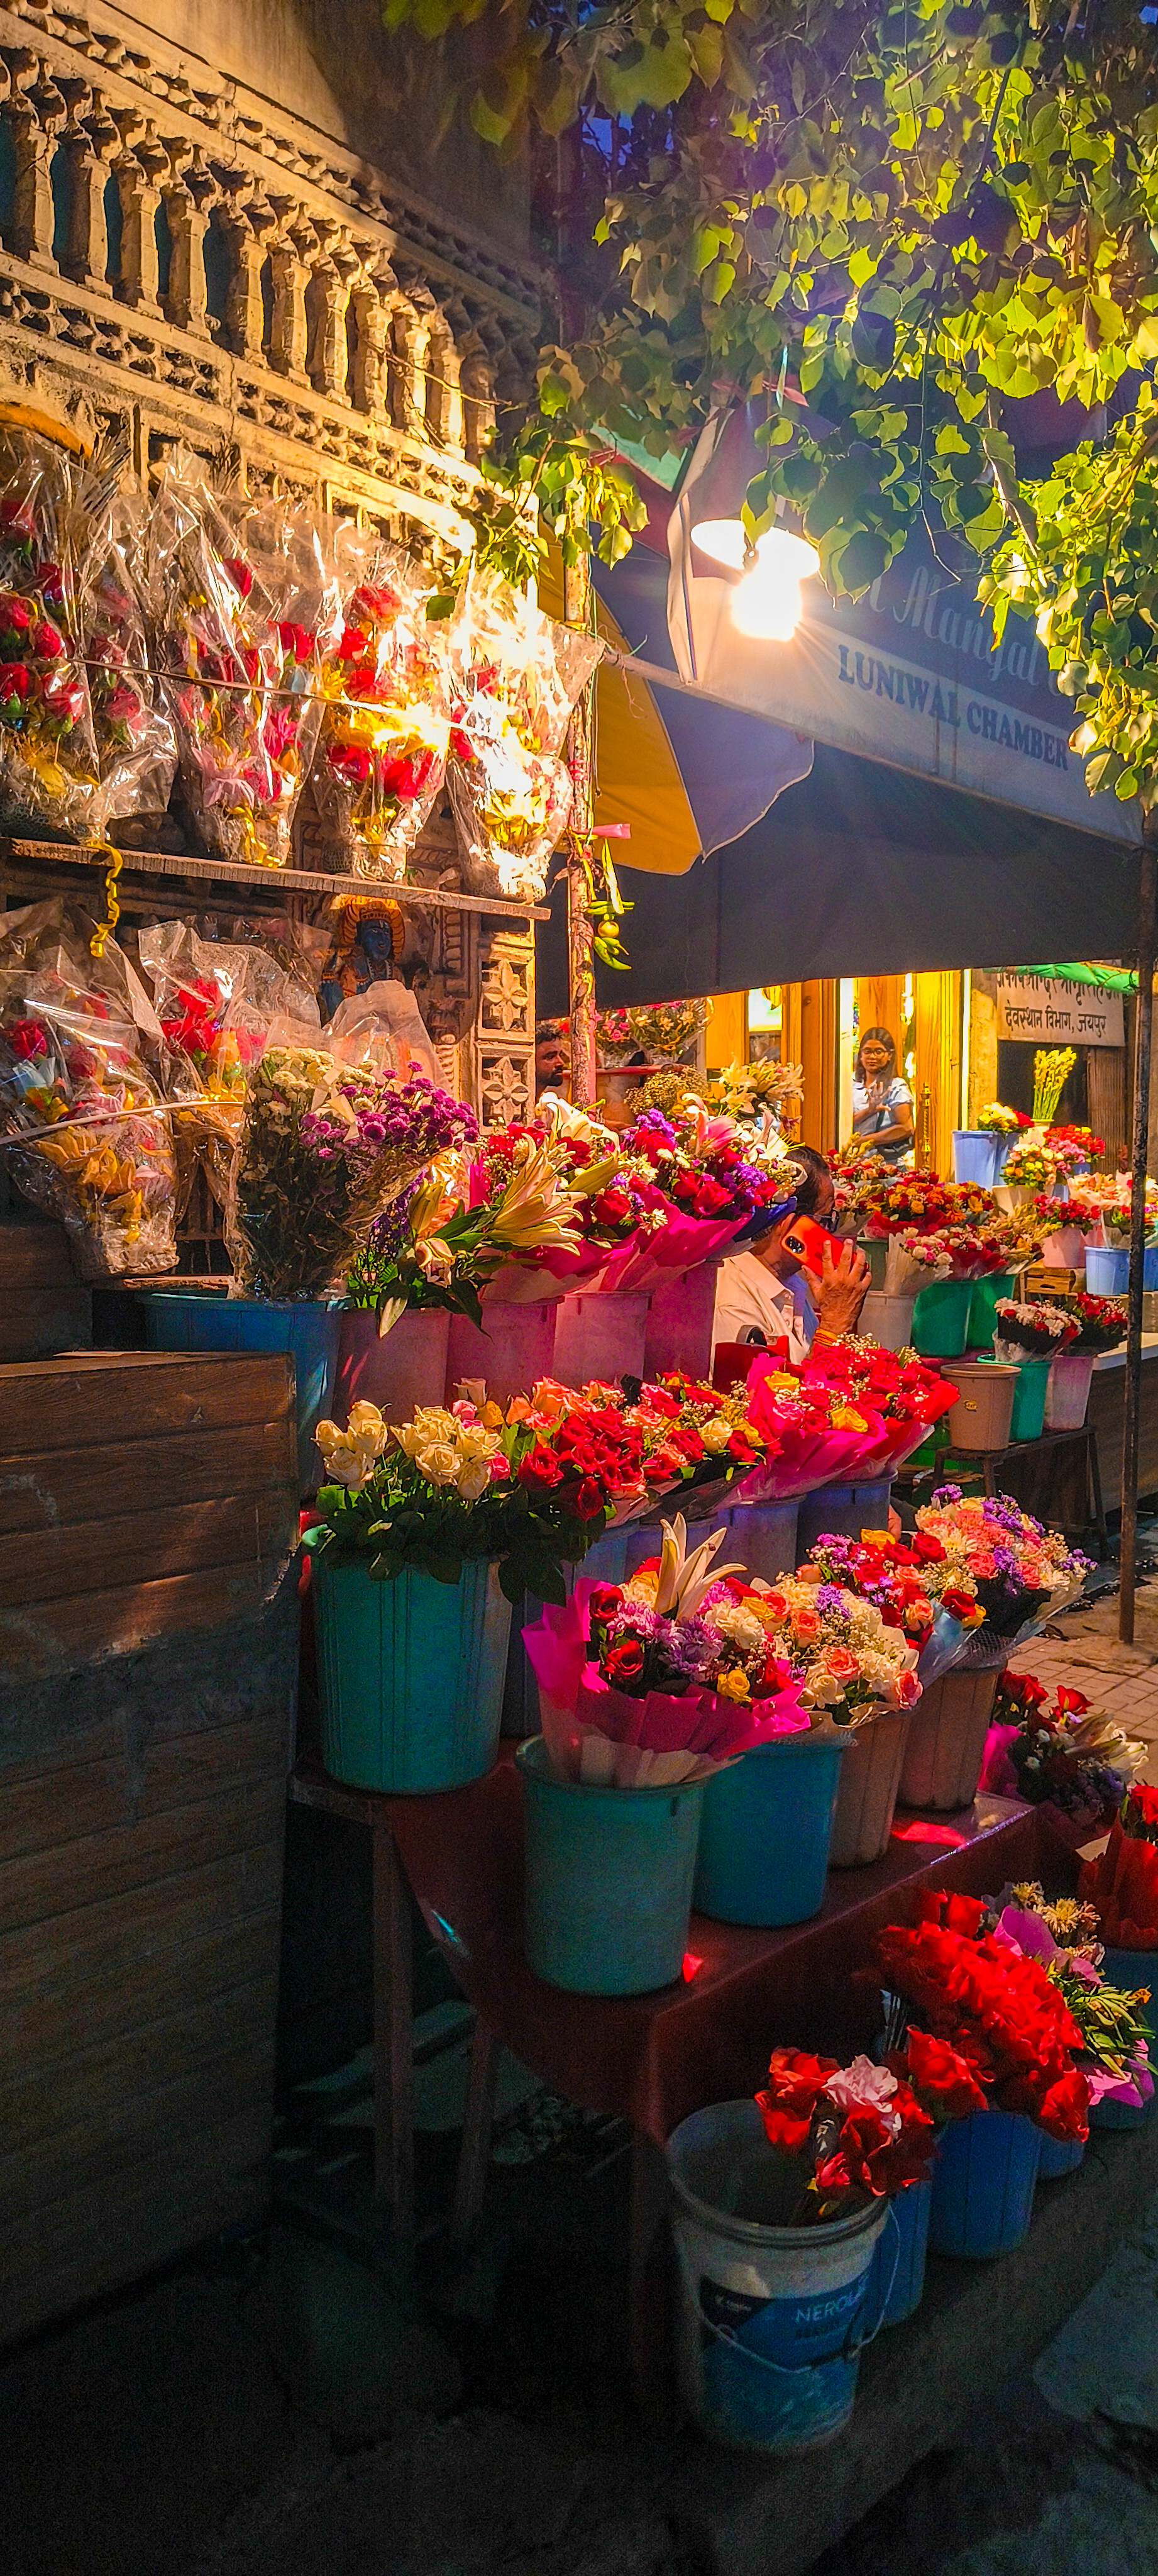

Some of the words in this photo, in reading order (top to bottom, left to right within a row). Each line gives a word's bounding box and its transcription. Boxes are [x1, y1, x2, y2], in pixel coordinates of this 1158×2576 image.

[838, 644, 961, 728] LUNIWAL
[966, 701, 1069, 771] CHAMBER
[1005, 999, 1042, 1031] देवस्थान
[1045, 1005, 1074, 1033] विभाग,
[1077, 1013, 1106, 1038] जयपुर
